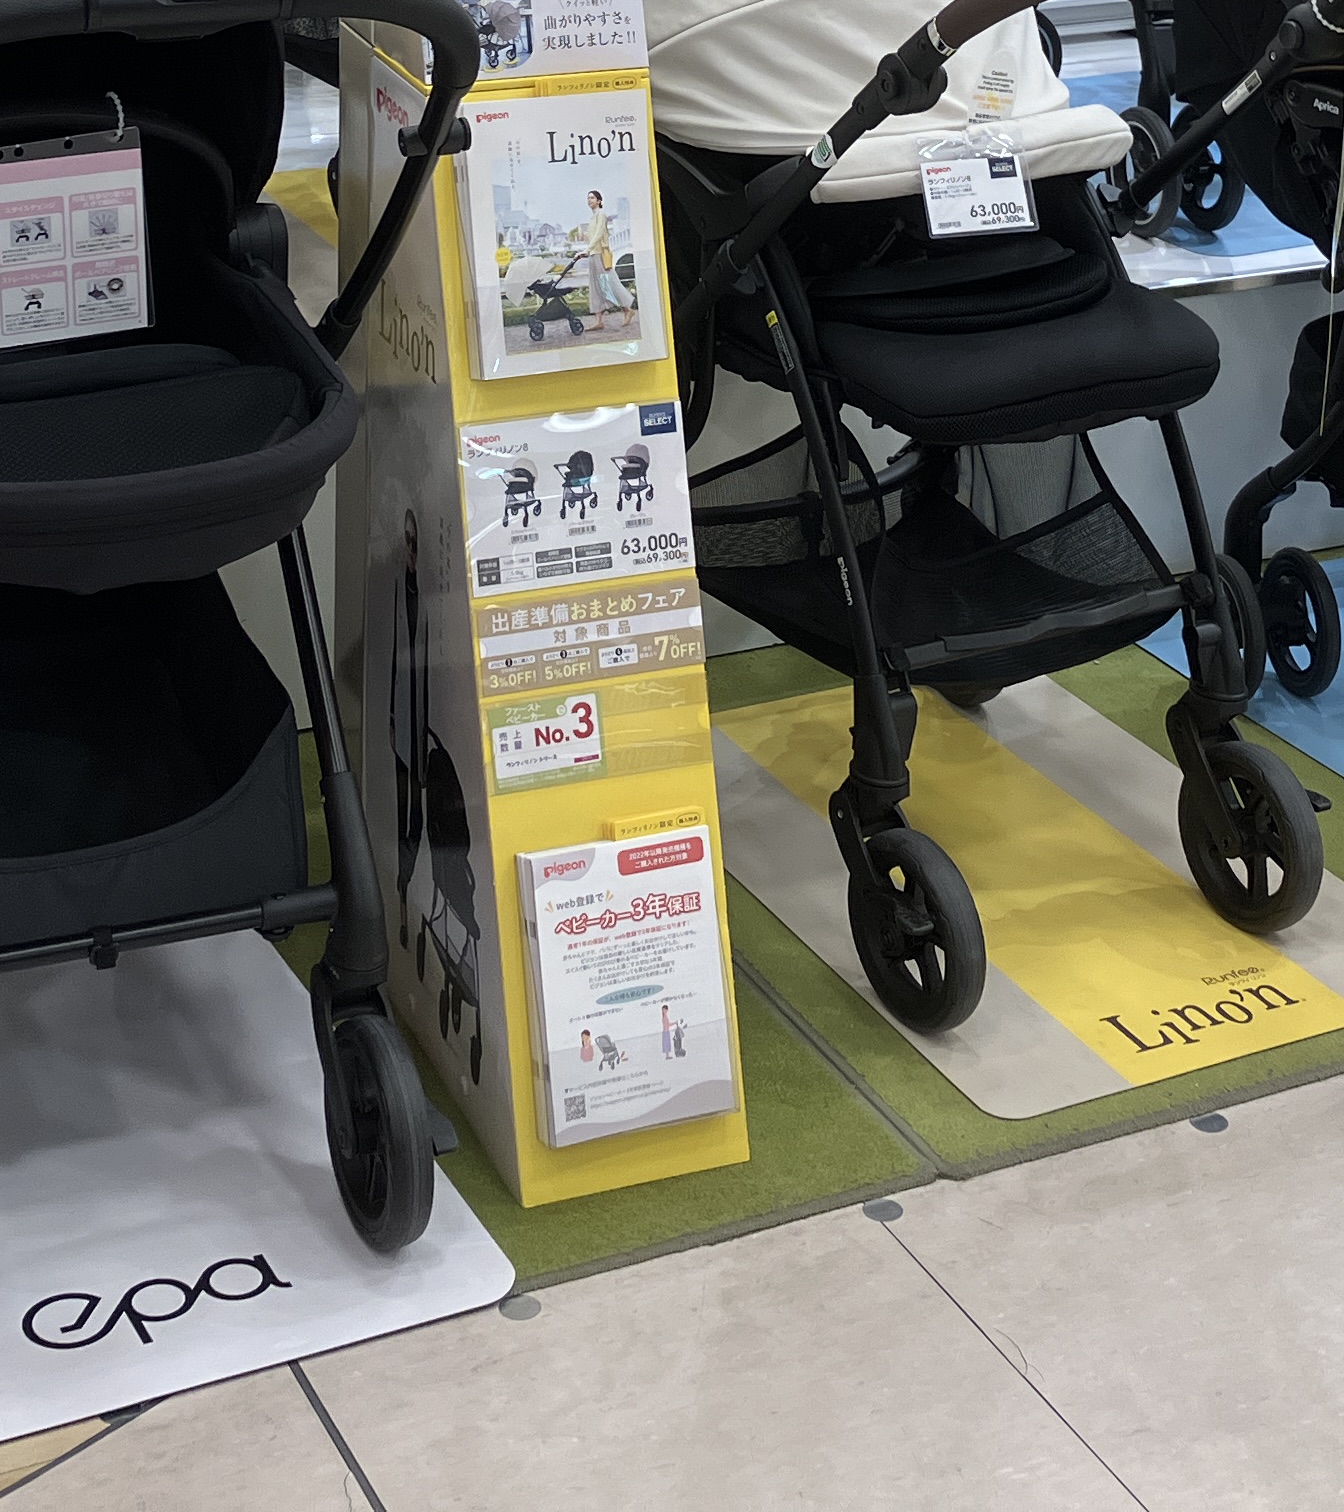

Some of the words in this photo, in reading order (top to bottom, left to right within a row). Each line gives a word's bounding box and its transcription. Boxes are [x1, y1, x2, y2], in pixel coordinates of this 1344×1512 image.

[544, 12, 631, 31] 曲がりやすさを
[542, 31, 637, 51] 実現しました!!
[476, 111, 510, 123] pigeon
[546, 130, 636, 165] Lino'n
[926, 166, 952, 175] pigeon
[928, 175, 972, 186] ランフィリノン8
[970, 202, 1025, 218] 63,000円
[379, 279, 437, 385] Lino'n
[643, 416, 672, 427] SELECT
[621, 533, 688, 555] 63,000円
[491, 588, 686, 634] 出産準備おまとめフェア
[553, 620, 631, 644] 対象商品
[505, 704, 540, 715] ファースト
[506, 712, 546, 724] ベビーカー
[543, 859, 586, 878] pigeon
[556, 892, 604, 911] web登録で
[555, 892, 700, 935] ベビーカー3年保証
[1100, 984, 1301, 1055] Lino'n
[22, 1253, 293, 1345] epa
